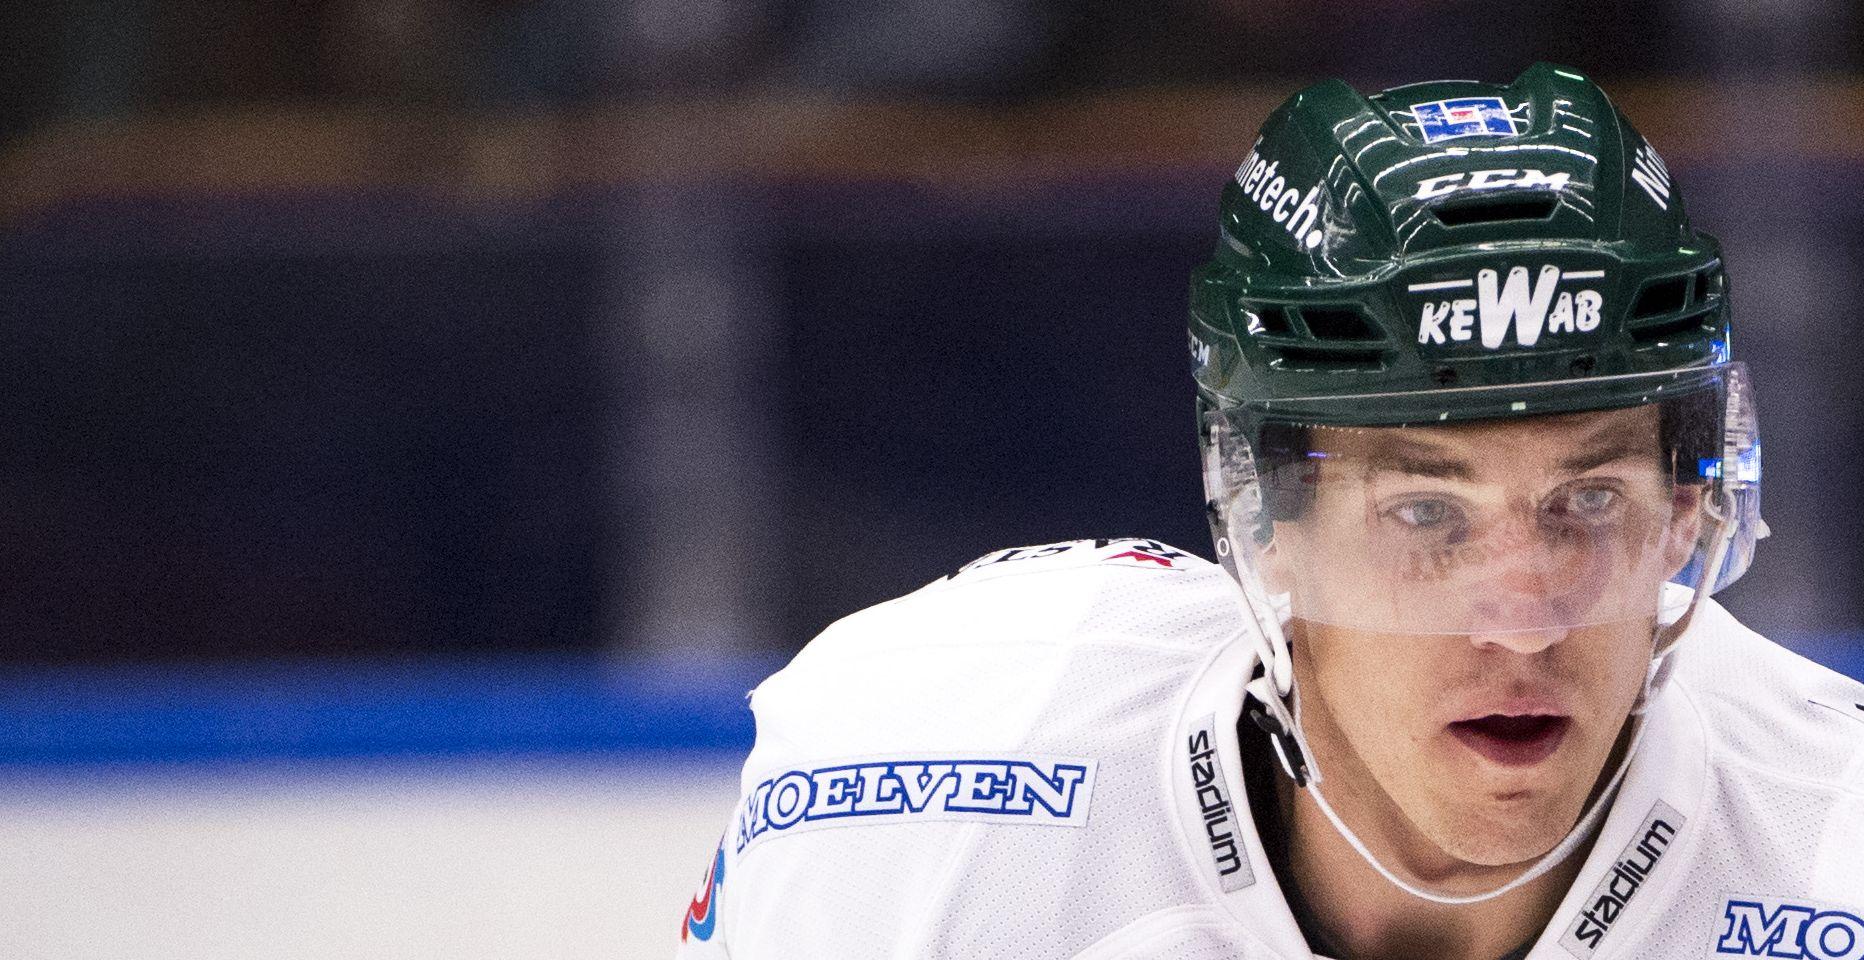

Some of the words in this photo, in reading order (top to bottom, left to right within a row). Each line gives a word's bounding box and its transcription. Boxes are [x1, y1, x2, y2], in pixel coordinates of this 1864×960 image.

[1411, 169, 1571, 200] CCM
[736, 759, 1086, 855] MOELVEN
[1186, 728, 1242, 877] stadium
[1575, 818, 1676, 949] stadium
